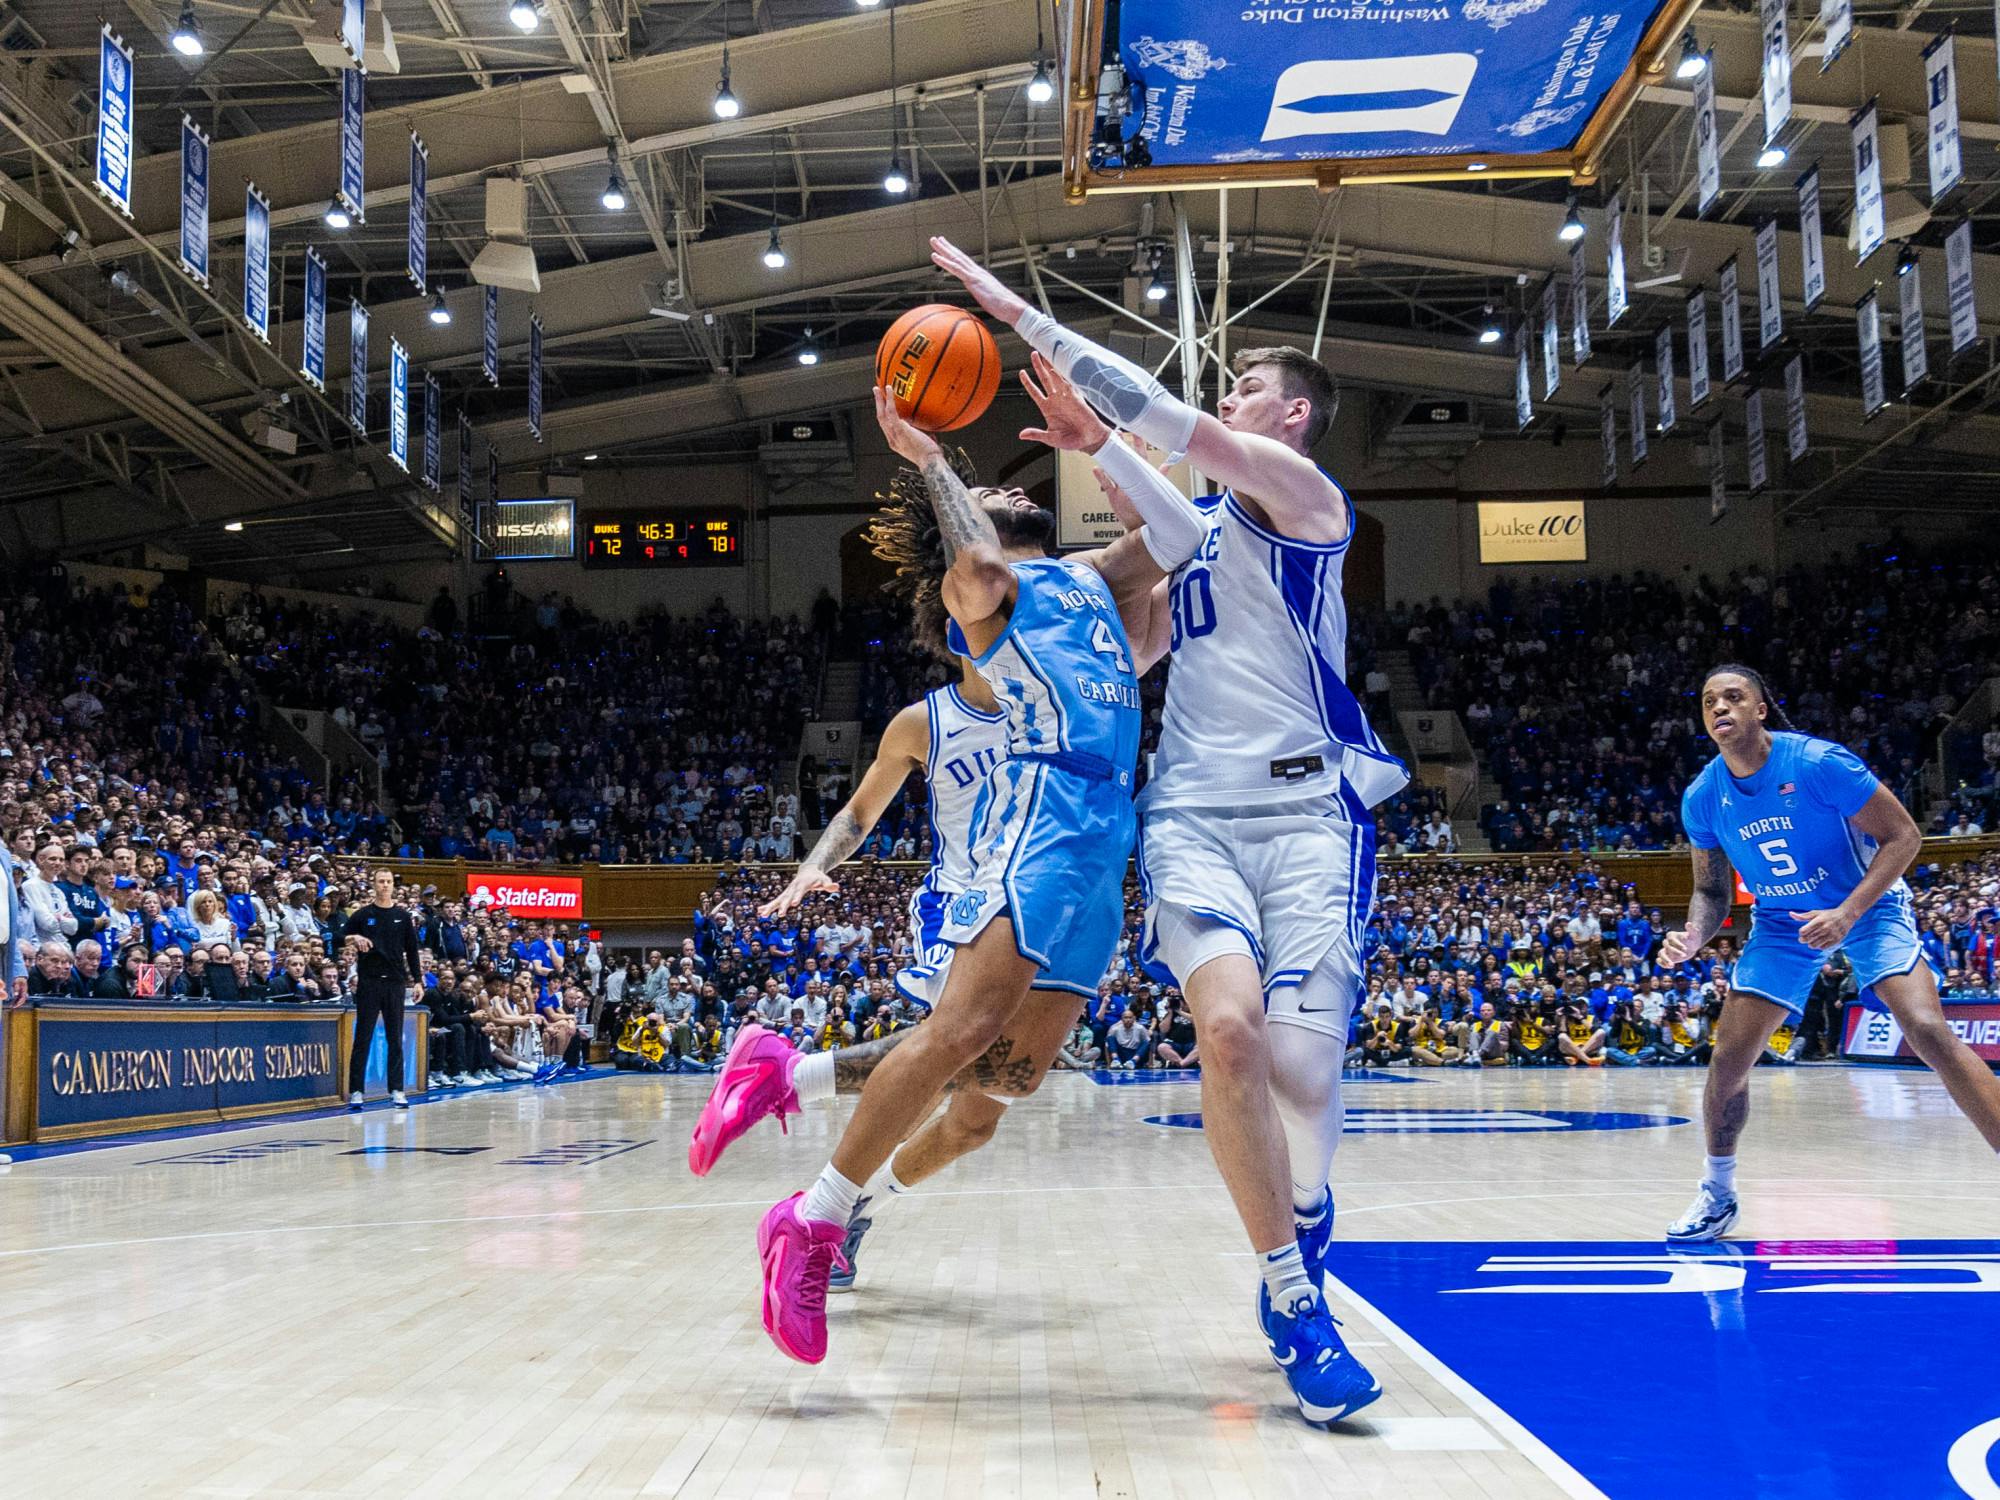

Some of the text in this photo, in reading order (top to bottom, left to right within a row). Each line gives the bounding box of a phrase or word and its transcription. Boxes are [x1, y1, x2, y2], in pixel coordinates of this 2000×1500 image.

[1241, 7, 1450, 24] Washington Duke
[1533, 15, 1594, 109] Washington Duke
[1563, 14, 1621, 99] Inn & Golf Club
[706, 522, 728, 531] UNC
[1081, 513, 1119, 523] CAREE
[1482, 514, 1582, 537] Duke 100
[496, 521, 570, 537] ISSAN
[594, 525, 621, 534] DUKE
[639, 523, 675, 540] 46.3
[601, 539, 622, 555] 72
[644, 546, 654, 559] 9
[678, 545, 688, 558] 9
[707, 536, 728, 552] 78
[1090, 617, 1133, 674] 4
[1075, 675, 1141, 711] CARLI
[1737, 815, 1795, 841] NORTH
[1757, 837, 1799, 878] 5
[1755, 866, 1830, 898] CAROLINA
[72, 892, 97, 910] Duke
[52, 1043, 330, 1096] CAMERON INDOOR STADIUM
